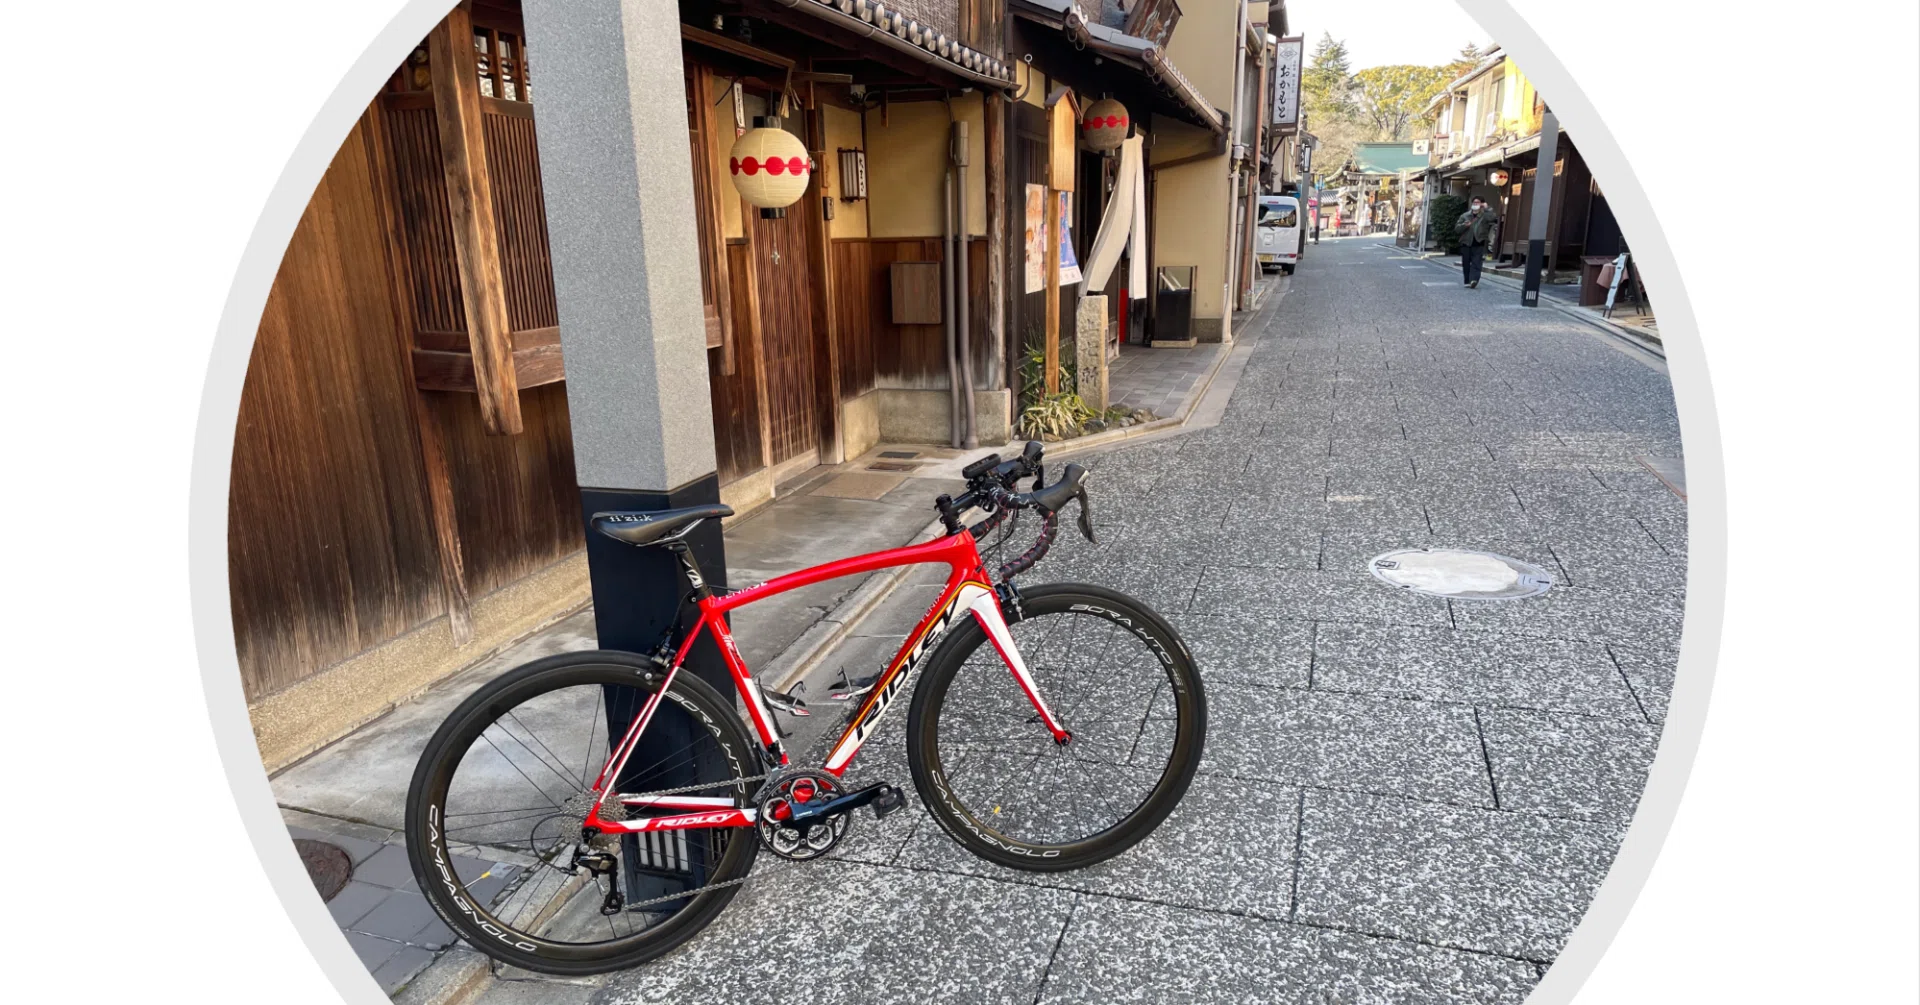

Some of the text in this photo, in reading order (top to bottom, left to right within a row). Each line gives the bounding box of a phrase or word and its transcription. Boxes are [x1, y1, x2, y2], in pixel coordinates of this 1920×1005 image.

[1278, 64, 1291, 119] おかもと
[1069, 603, 1132, 627] BORA
[664, 690, 722, 738] BORA
[656, 812, 739, 828] RIDLEY
[931, 769, 1061, 858] CAMPAGNOLO
[428, 803, 538, 952] CAMPAGNOLO
